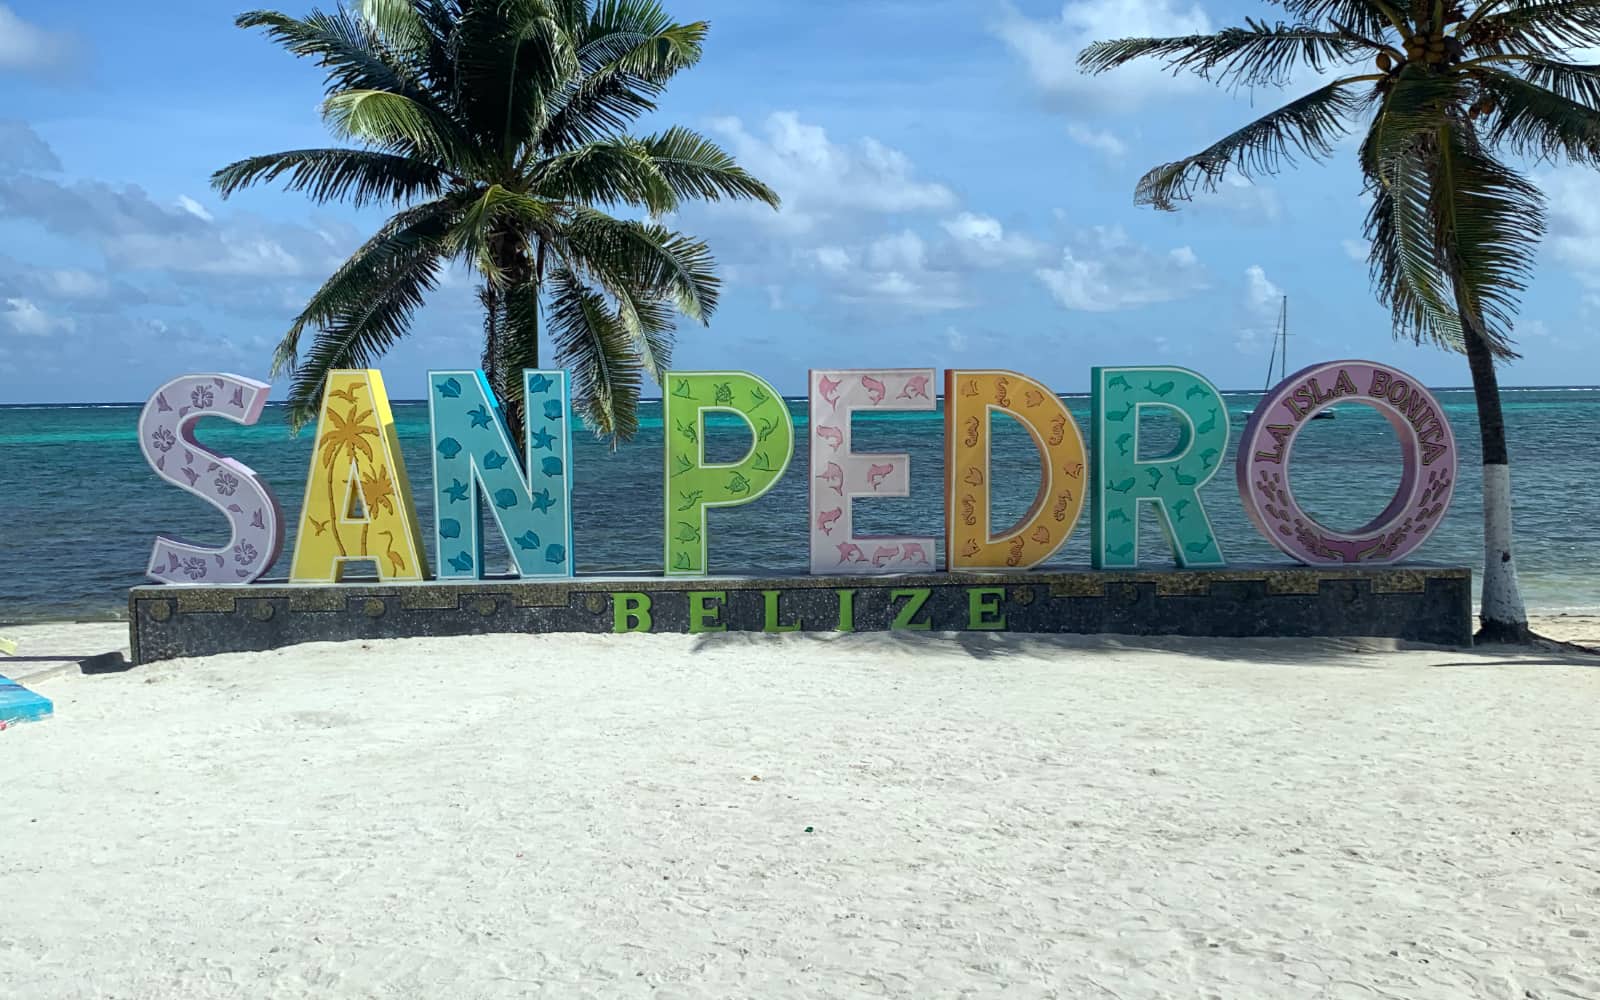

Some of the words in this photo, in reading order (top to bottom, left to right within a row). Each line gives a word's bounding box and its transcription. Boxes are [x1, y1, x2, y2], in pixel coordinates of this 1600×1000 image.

[1255, 423, 1294, 464] LA
[1283, 369, 1358, 422] ISLA
[1368, 369, 1448, 466] BONITA
[137, 369, 574, 585] SAN
[663, 360, 1456, 575] PEDRO
[611, 587, 1008, 634] BELIZE
